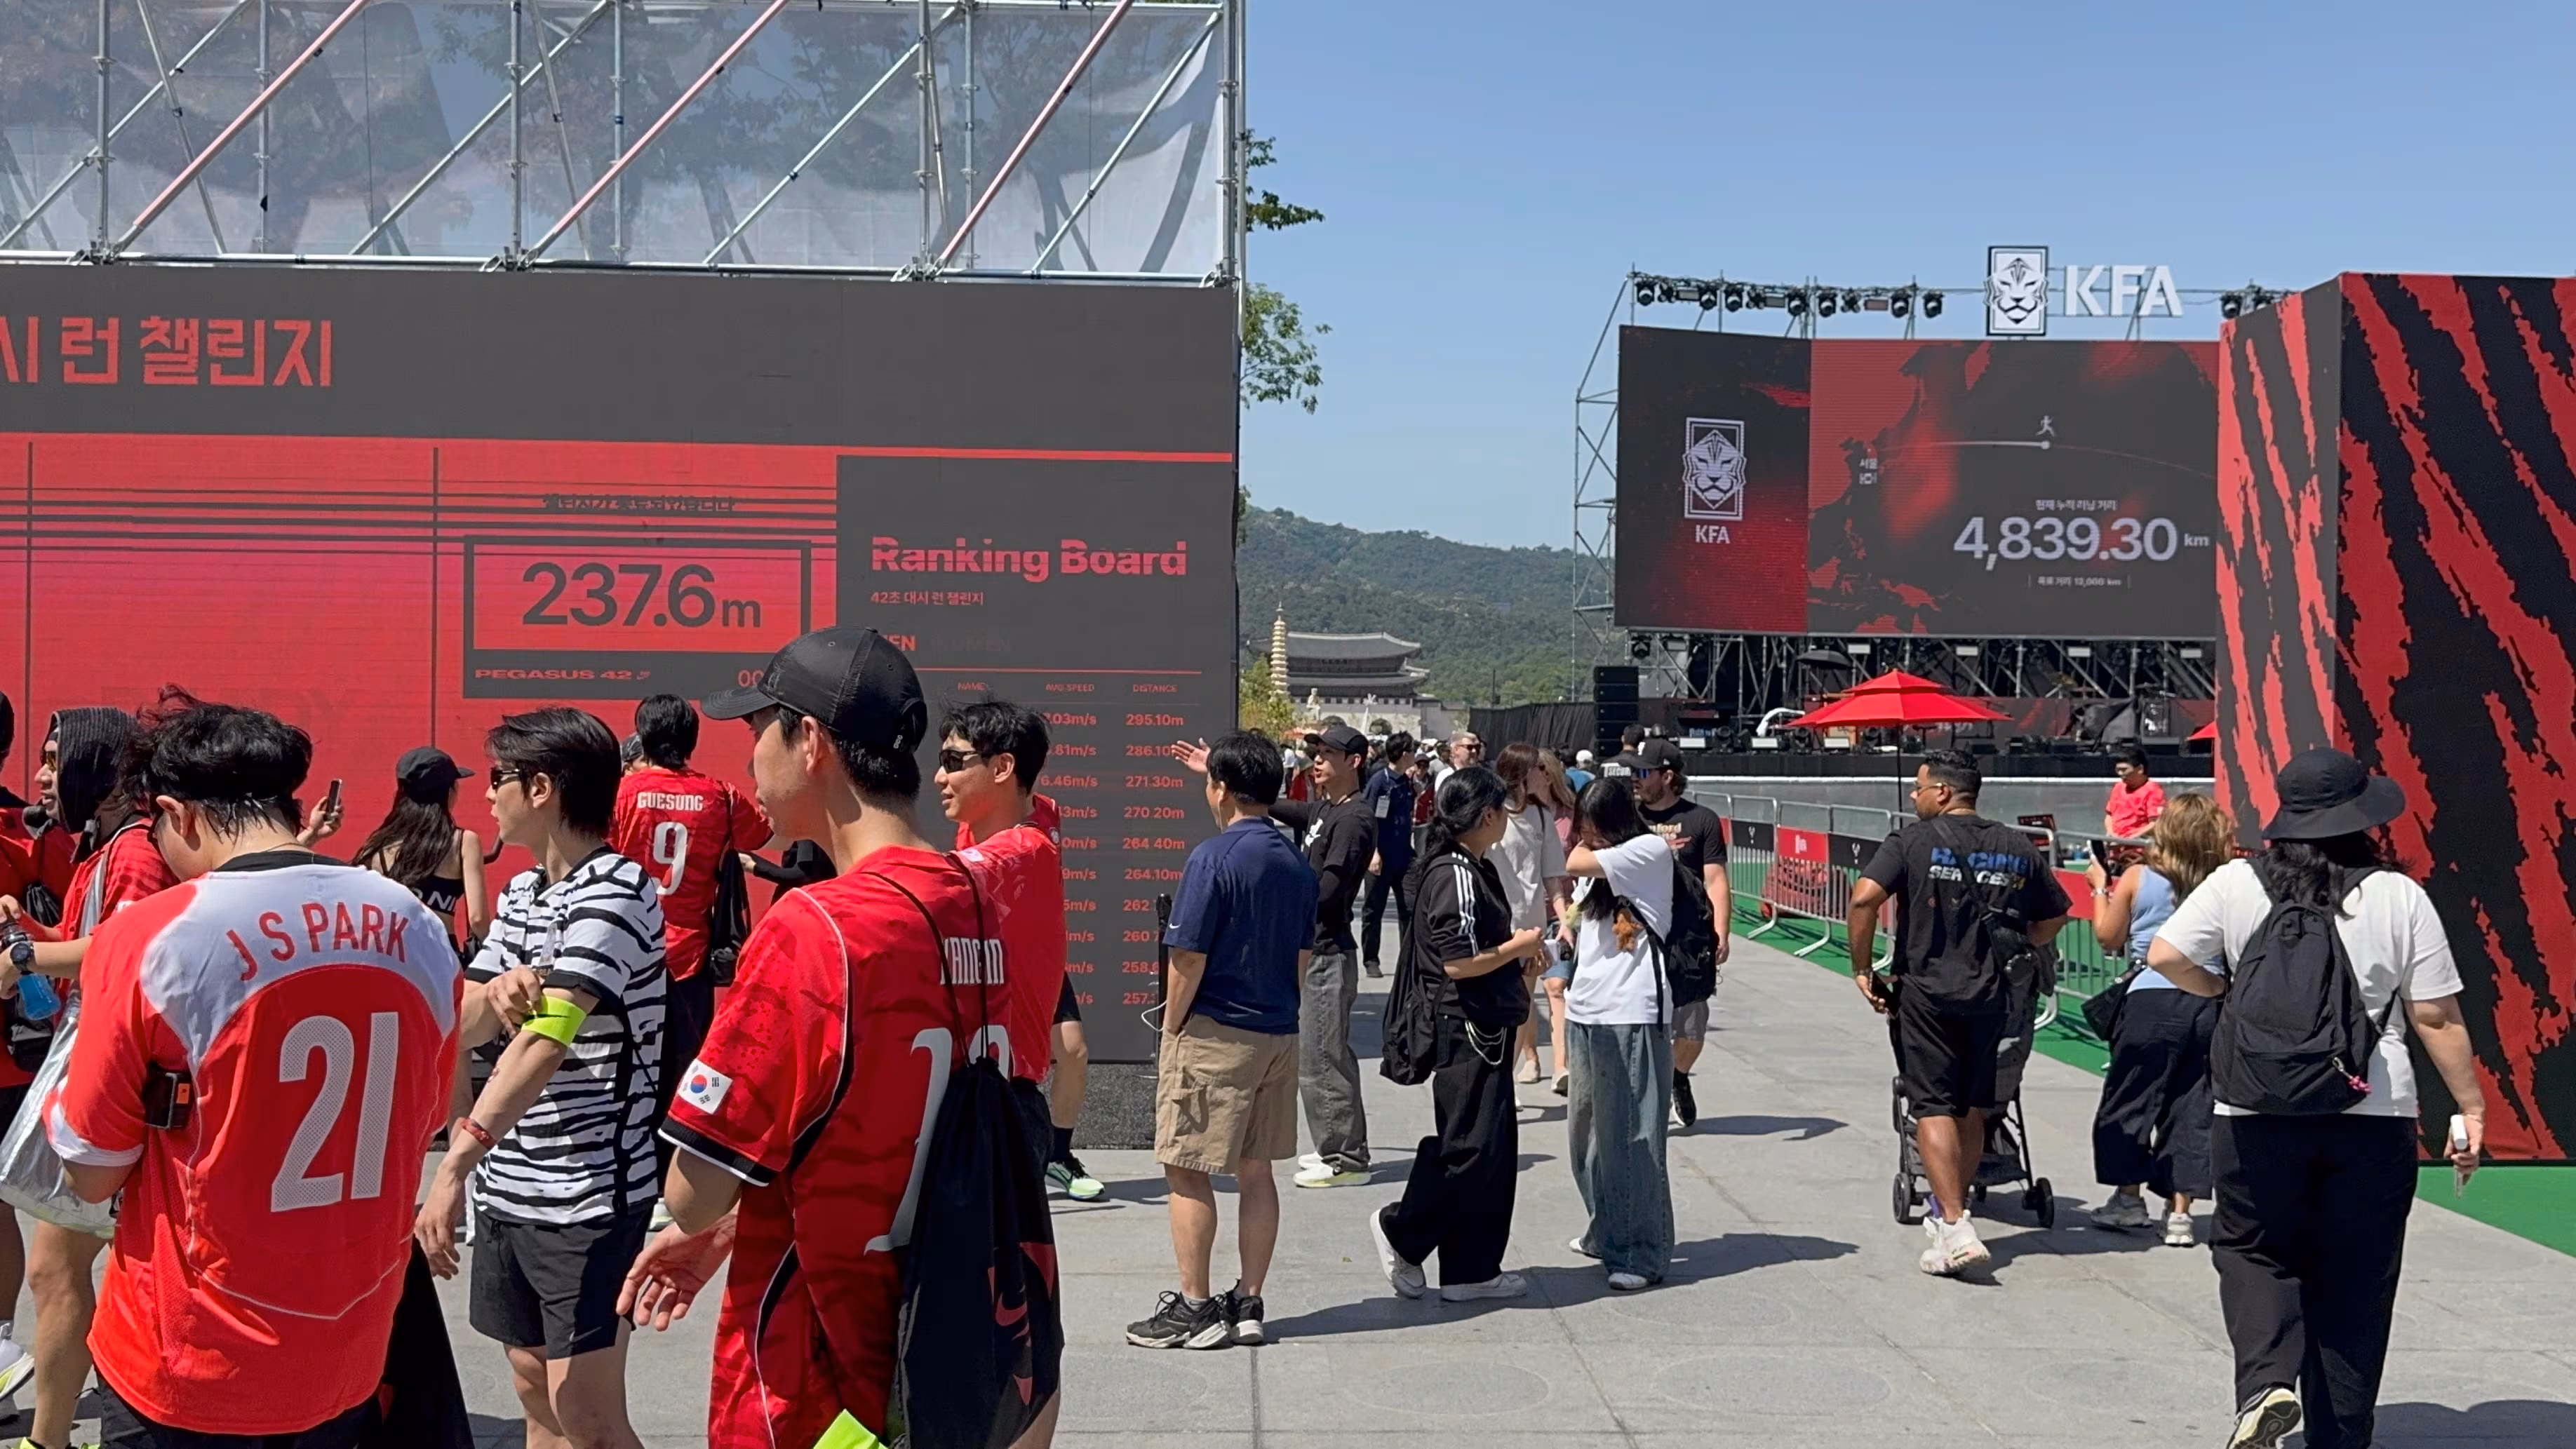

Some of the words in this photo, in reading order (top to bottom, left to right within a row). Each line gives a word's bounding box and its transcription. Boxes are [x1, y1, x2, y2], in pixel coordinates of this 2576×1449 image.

[2062, 264, 2185, 316] KFA
[60, 316, 120, 384] 런
[140, 315, 333, 387] 챌린지
[1694, 524, 1731, 545] KFA
[1953, 515, 2178, 571] 4,839.30
[2184, 532, 2210, 548] km
[872, 536, 1049, 583] Ranking
[1061, 539, 1188, 576] Board
[871, 591, 901, 605] 42초
[904, 591, 928, 605] 대시
[932, 591, 944, 605] 런
[948, 591, 984, 606] 챌린지
[883, 635, 916, 652] EN
[475, 669, 596, 680] PEGASUS
[600, 670, 632, 680] 42
[957, 682, 986, 691] NAME
[1132, 684, 1179, 693] DISTANCE
[1125, 713, 1183, 726] 295.10m
[1048, 743, 1097, 757] .81m/s
[1125, 745, 1173, 757] 286.10
[1040, 774, 1098, 788] 6.46m/s
[1125, 776, 1183, 788] 271.30m
[637, 791, 704, 811] GUESUNG
[1123, 807, 1185, 819] 27020m
[1122, 837, 1185, 849] 26440m
[652, 821, 688, 896] 9
[226, 929, 257, 981] J
[259, 911, 295, 962] S
[302, 901, 409, 964] PARK
[271, 1011, 399, 1213] 21
